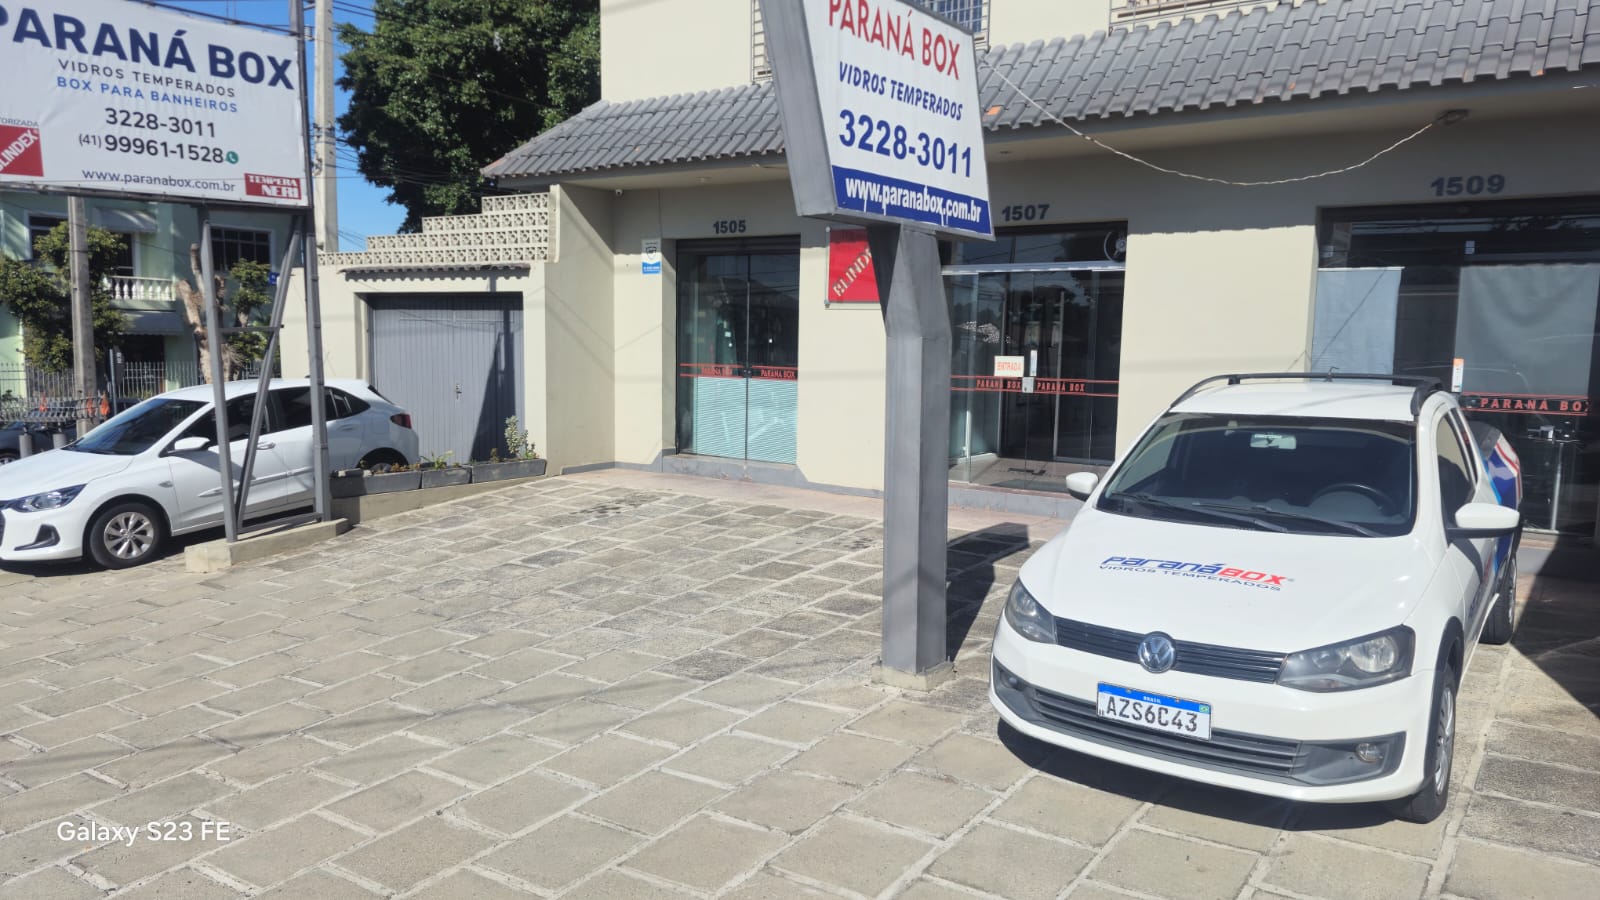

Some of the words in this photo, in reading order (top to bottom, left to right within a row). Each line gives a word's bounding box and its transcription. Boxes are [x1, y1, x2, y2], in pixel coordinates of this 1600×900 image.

[0, 4, 196, 73] ARANÁ
[208, 44, 295, 90] BOX
[829, 0, 915, 61] PARANÁ
[922, 27, 961, 80] BOX
[57, 76, 92, 92] BOX
[101, 83, 144, 99] PARA
[150, 91, 238, 112] BANHEIROS
[58, 59, 125, 79] VIDROS
[133, 71, 236, 98] TEMPERADOS
[839, 61, 887, 96] VIDROS
[890, 79, 963, 121] TEMPERADOS
[105, 107, 215, 138] 3228-3011
[79, 133, 102, 149] (41)
[105, 134, 224, 163] 99961-1528
[839, 109, 971, 178] 3228-3011
[82, 169, 236, 192] www.paranabox.com.br
[261, 184, 299, 199] NERI
[1431, 174, 1505, 197] 1509
[845, 177, 982, 224] www.paranabox.com.br
[1002, 204, 1050, 222] 1507
[713, 220, 747, 234] 1505
[1069, 383, 1085, 392] BOX
[1099, 565, 1156, 573] VIDROS
[1163, 571, 1281, 592] TEMPERADOS
[1107, 696, 1198, 732] AZS6C43
